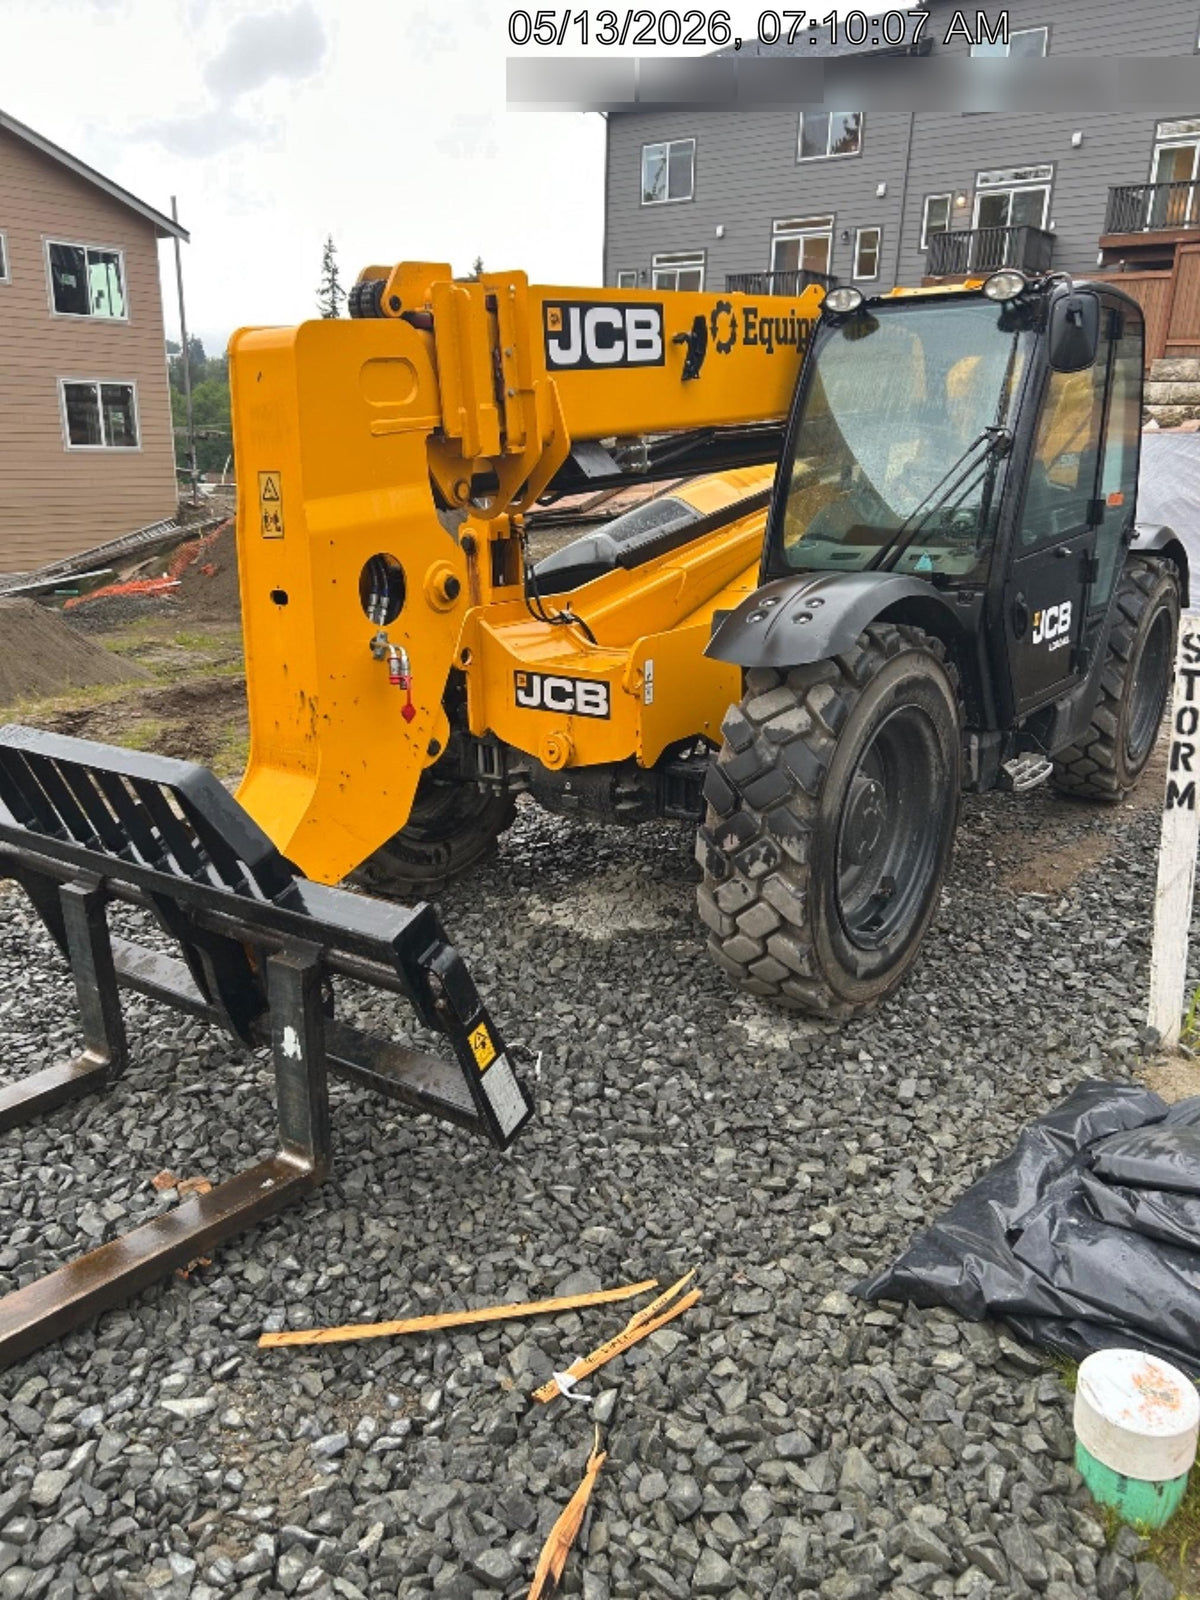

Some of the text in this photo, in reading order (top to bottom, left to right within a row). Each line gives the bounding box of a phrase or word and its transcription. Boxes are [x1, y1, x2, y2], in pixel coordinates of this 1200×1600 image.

[547, 306, 663, 364] JCB
[1032, 600, 1072, 645] JCB
[516, 674, 609, 716] JCB
[1165, 632, 1200, 810] STORM
